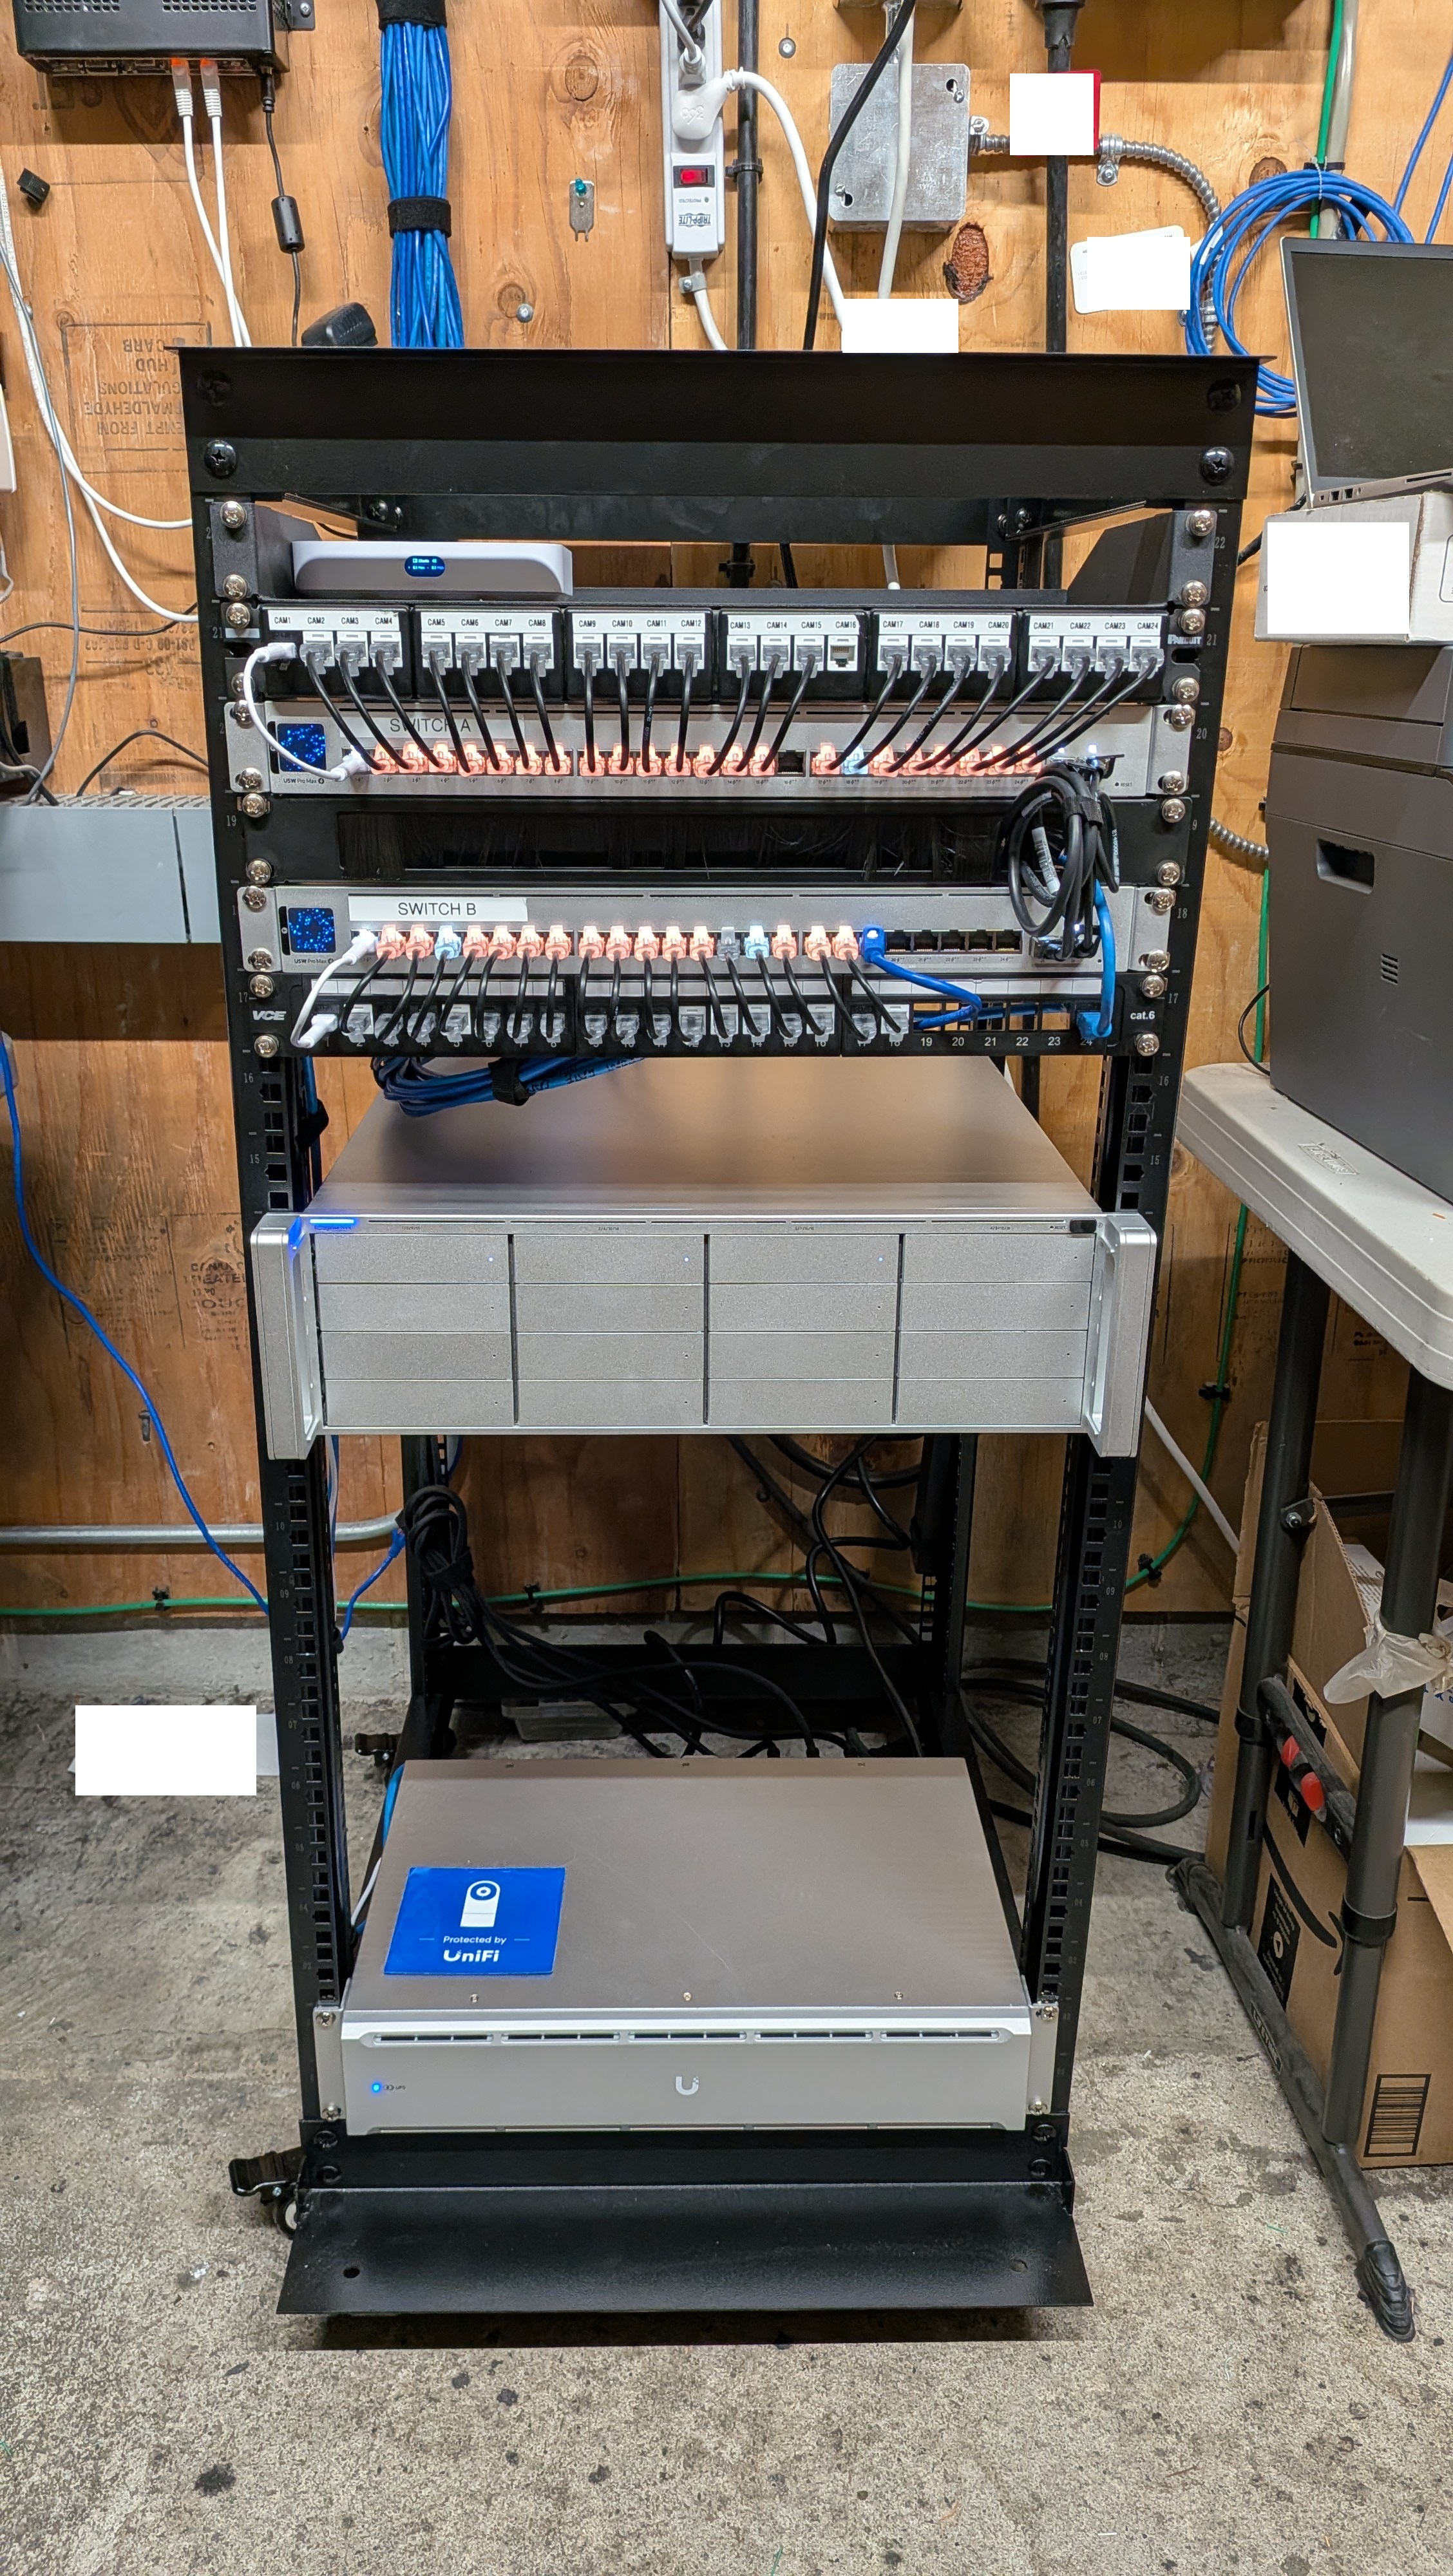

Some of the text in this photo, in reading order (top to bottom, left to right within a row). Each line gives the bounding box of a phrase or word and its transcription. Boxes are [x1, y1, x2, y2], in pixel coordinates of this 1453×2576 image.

[122, 338, 165, 352] CARB
[135, 358, 168, 372] HUD
[99, 381, 181, 394] GULATIONS
[97, 421, 184, 435] EMPT FROM
[1215, 536, 1226, 549] 22
[213, 627, 223, 639] 21
[1168, 634, 1202, 645] PANDUIT
[1206, 634, 1217, 646] 21
[460, 718, 471, 732] A
[1196, 728, 1207, 740] 20
[226, 815, 237, 827] 19
[398, 902, 477, 916] SWITCH B
[1177, 907, 1188, 918] 18
[238, 992, 249, 1003] 17
[1168, 993, 1179, 1004] 17
[252, 1010, 287, 1021] VCE
[1130, 1010, 1155, 1020] cat.6
[920, 1037, 933, 1046] 19
[952, 1037, 964, 1046] 20
[985, 1037, 996, 1046] 21
[1016, 1037, 1029, 1046] 22
[1048, 1037, 1061, 1046] 23
[1080, 1037, 1092, 1046] 24
[243, 1072, 254, 1083] 16
[1159, 1075, 1169, 1086] 16
[249, 1154, 260, 1164] 15
[1150, 1155, 1160, 1166] 15
[276, 1522, 285, 1531] 10
[1113, 1520, 1121, 1529] 10
[280, 1589, 289, 1598] 09
[1106, 1587, 1115, 1595] 09
[284, 1655, 293, 1664] 08
[1099, 1652, 1108, 1661] 08
[288, 1720, 298, 1729] 07
[1092, 1716, 1102, 1725] 07
[443, 1935, 507, 1946] Protected by
[443, 1949, 500, 1962] UniFi
